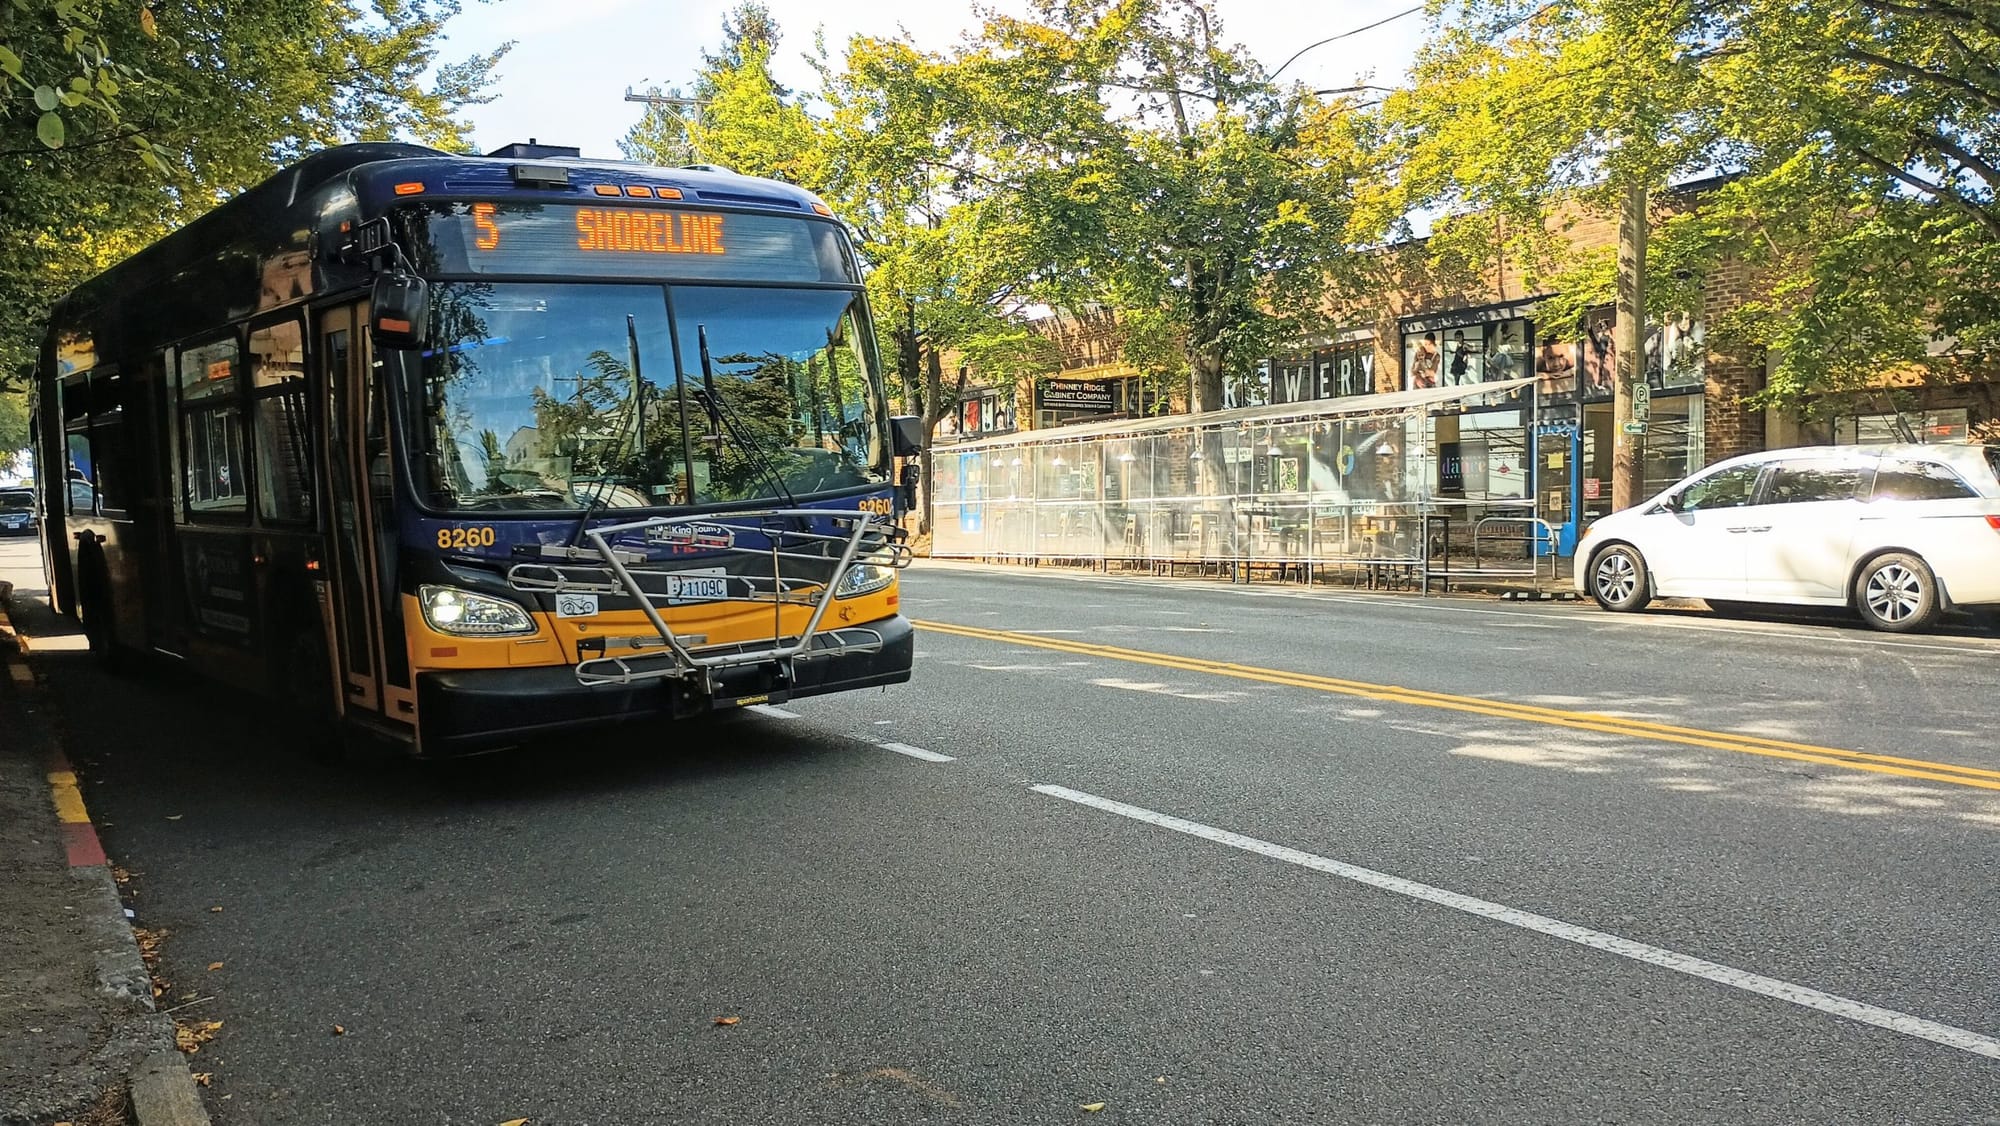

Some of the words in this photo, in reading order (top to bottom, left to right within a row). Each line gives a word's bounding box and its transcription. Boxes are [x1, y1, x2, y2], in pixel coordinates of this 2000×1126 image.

[474, 202, 498, 250] 5
[577, 209, 725, 254] SHORELINE
[1044, 391, 1075, 399] CABINET
[1076, 392, 1112, 401] COMPANY
[1050, 382, 1082, 392] PHINNEY
[1083, 383, 1106, 392] RIDGE
[1442, 457, 1487, 475] dance
[858, 498, 890, 516] 8260
[437, 527, 495, 549] 8260
[671, 526, 692, 535] King
[694, 525, 721, 533] ounty
[682, 580, 724, 598] 1109C
